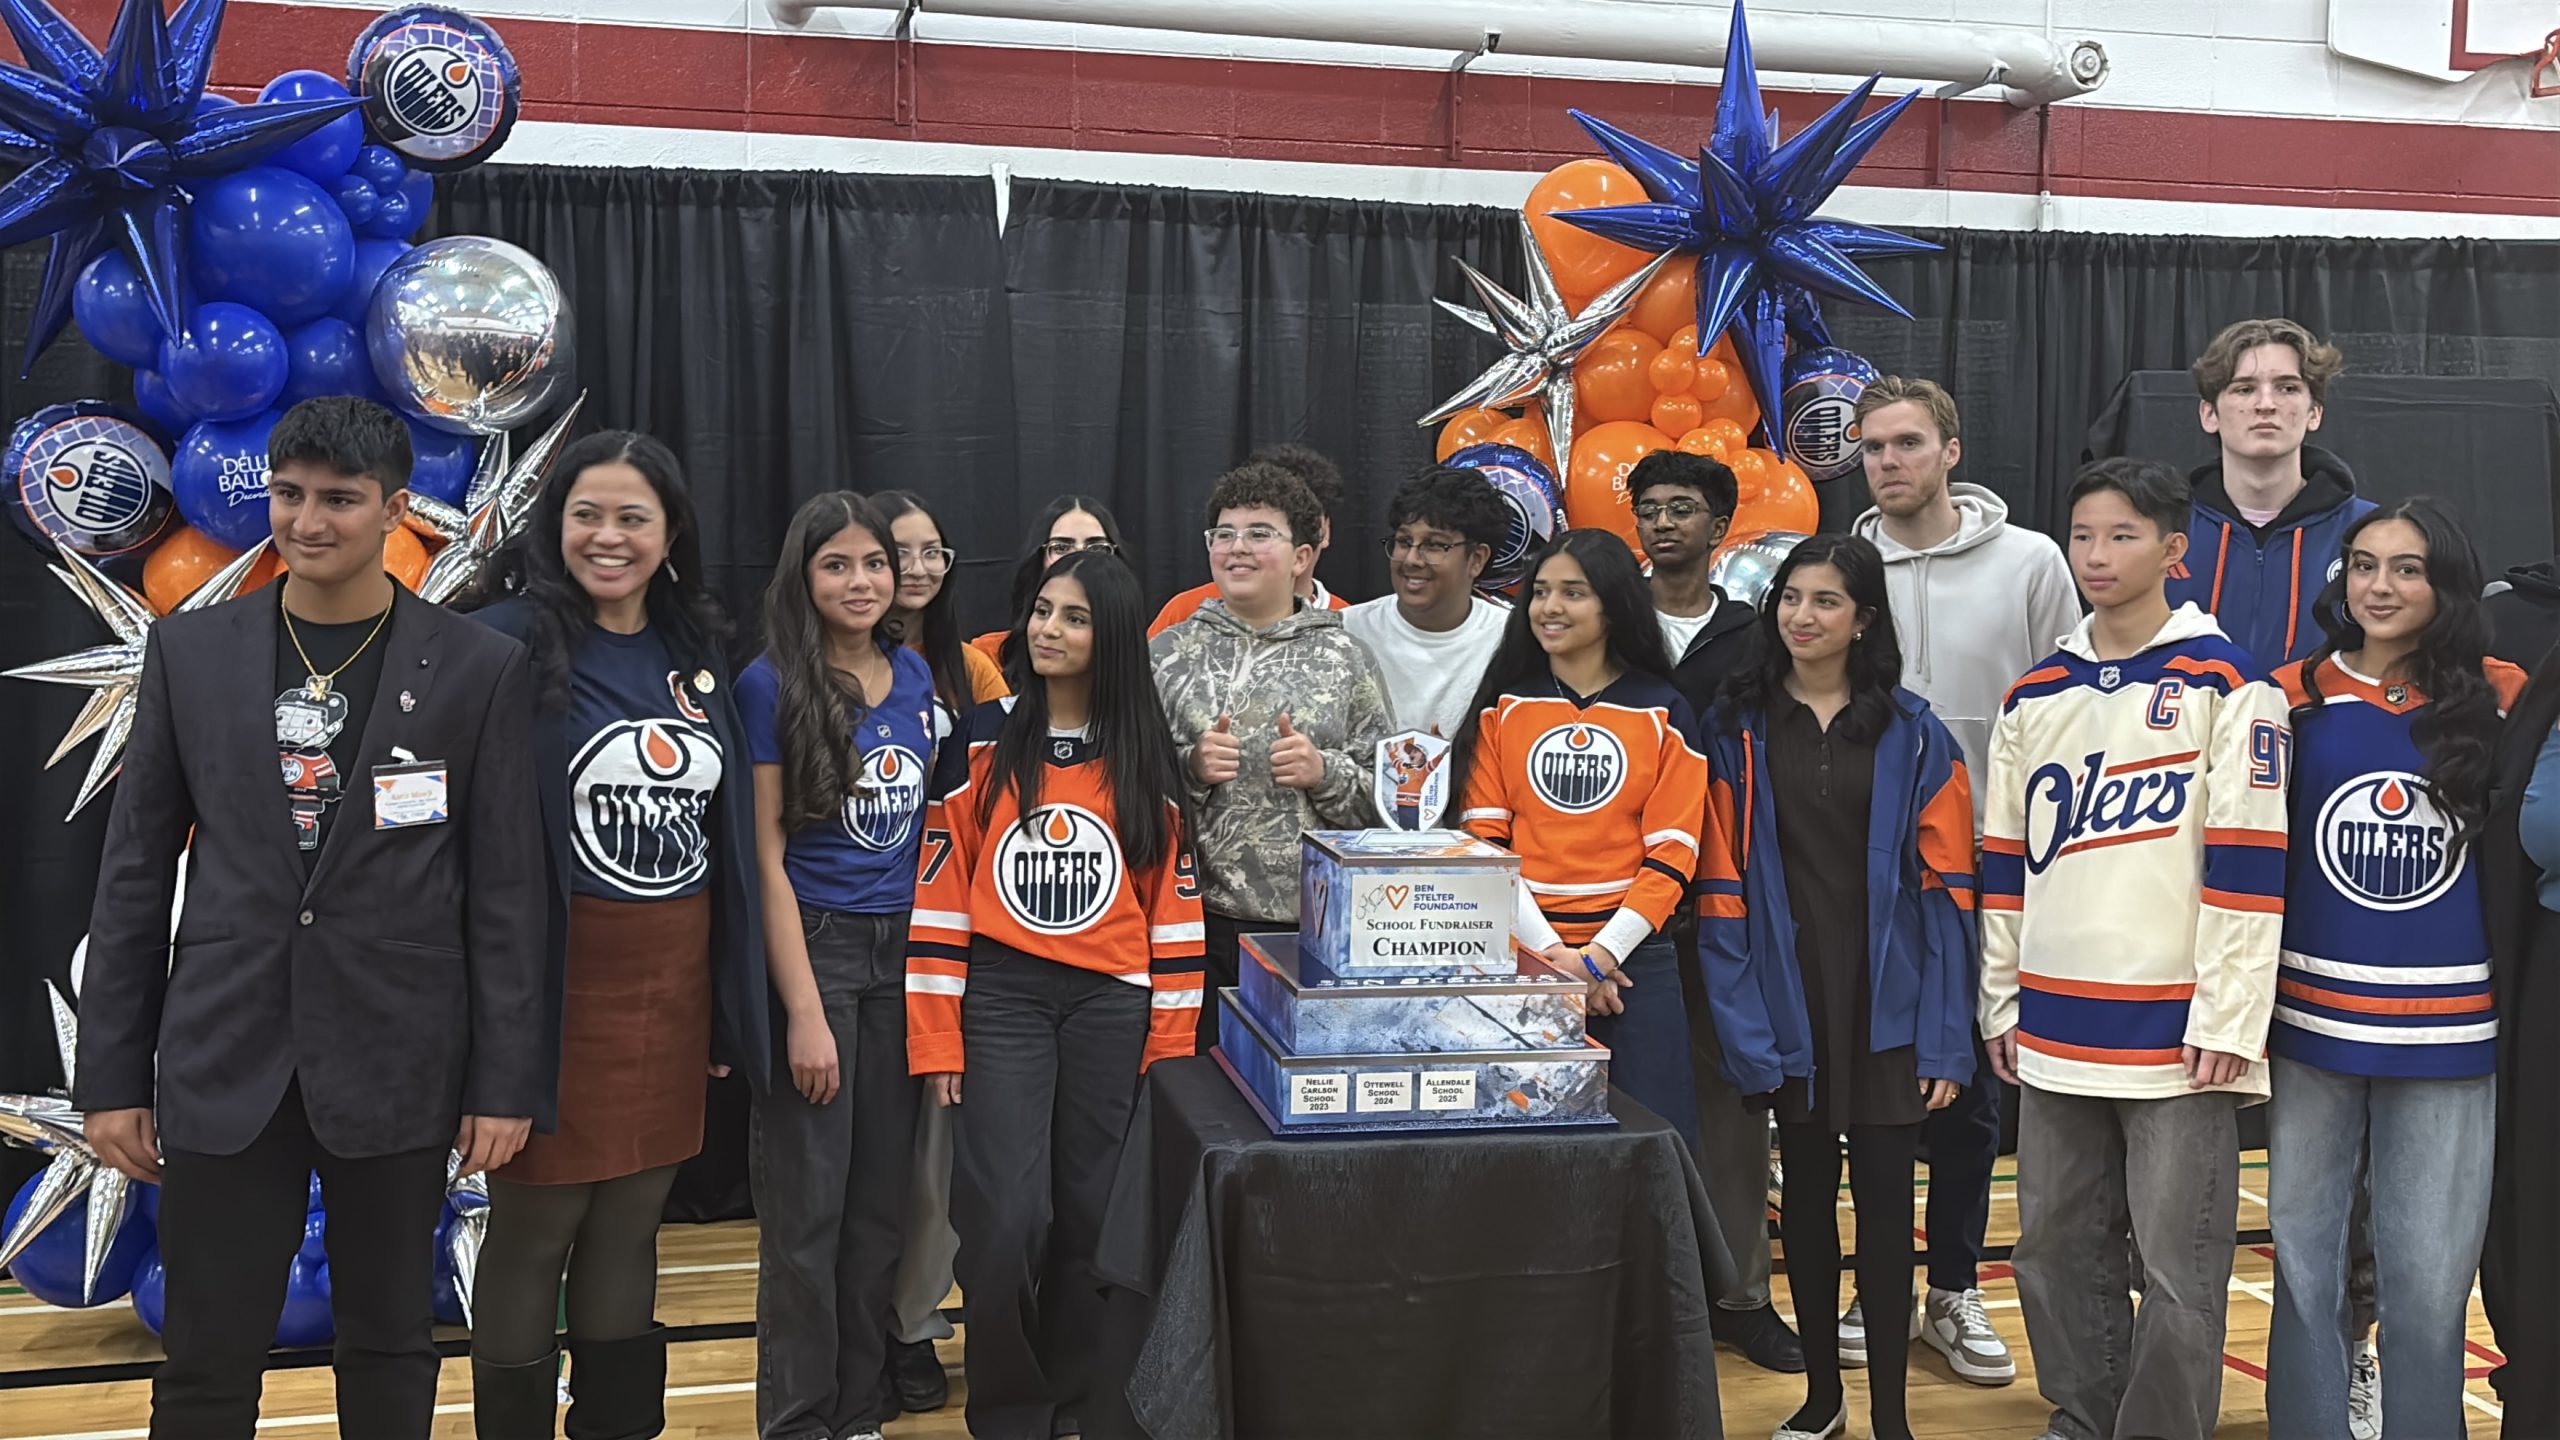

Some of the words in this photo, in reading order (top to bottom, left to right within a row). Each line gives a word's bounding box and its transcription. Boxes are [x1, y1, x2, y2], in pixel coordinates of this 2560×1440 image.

[394, 58, 467, 129] OILERS
[1795, 406, 1841, 460] OILERS
[75, 451, 143, 523] OILERS
[218, 470, 273, 492] BALLO
[2145, 677, 2185, 731] C
[1541, 752, 1612, 804] OILERS
[2025, 751, 2195, 875] Oilers
[2337, 820, 2445, 897] OILERS
[1014, 851, 1103, 923] OILERS
[1414, 884, 1435, 892] BEN
[1414, 893, 1455, 901] STELTER
[1414, 903, 1478, 911] FOUNDATION
[1309, 1103, 1330, 1111] 2023
[1373, 1097, 1394, 1105] 2024
[1438, 1095, 1458, 1103] 2025
